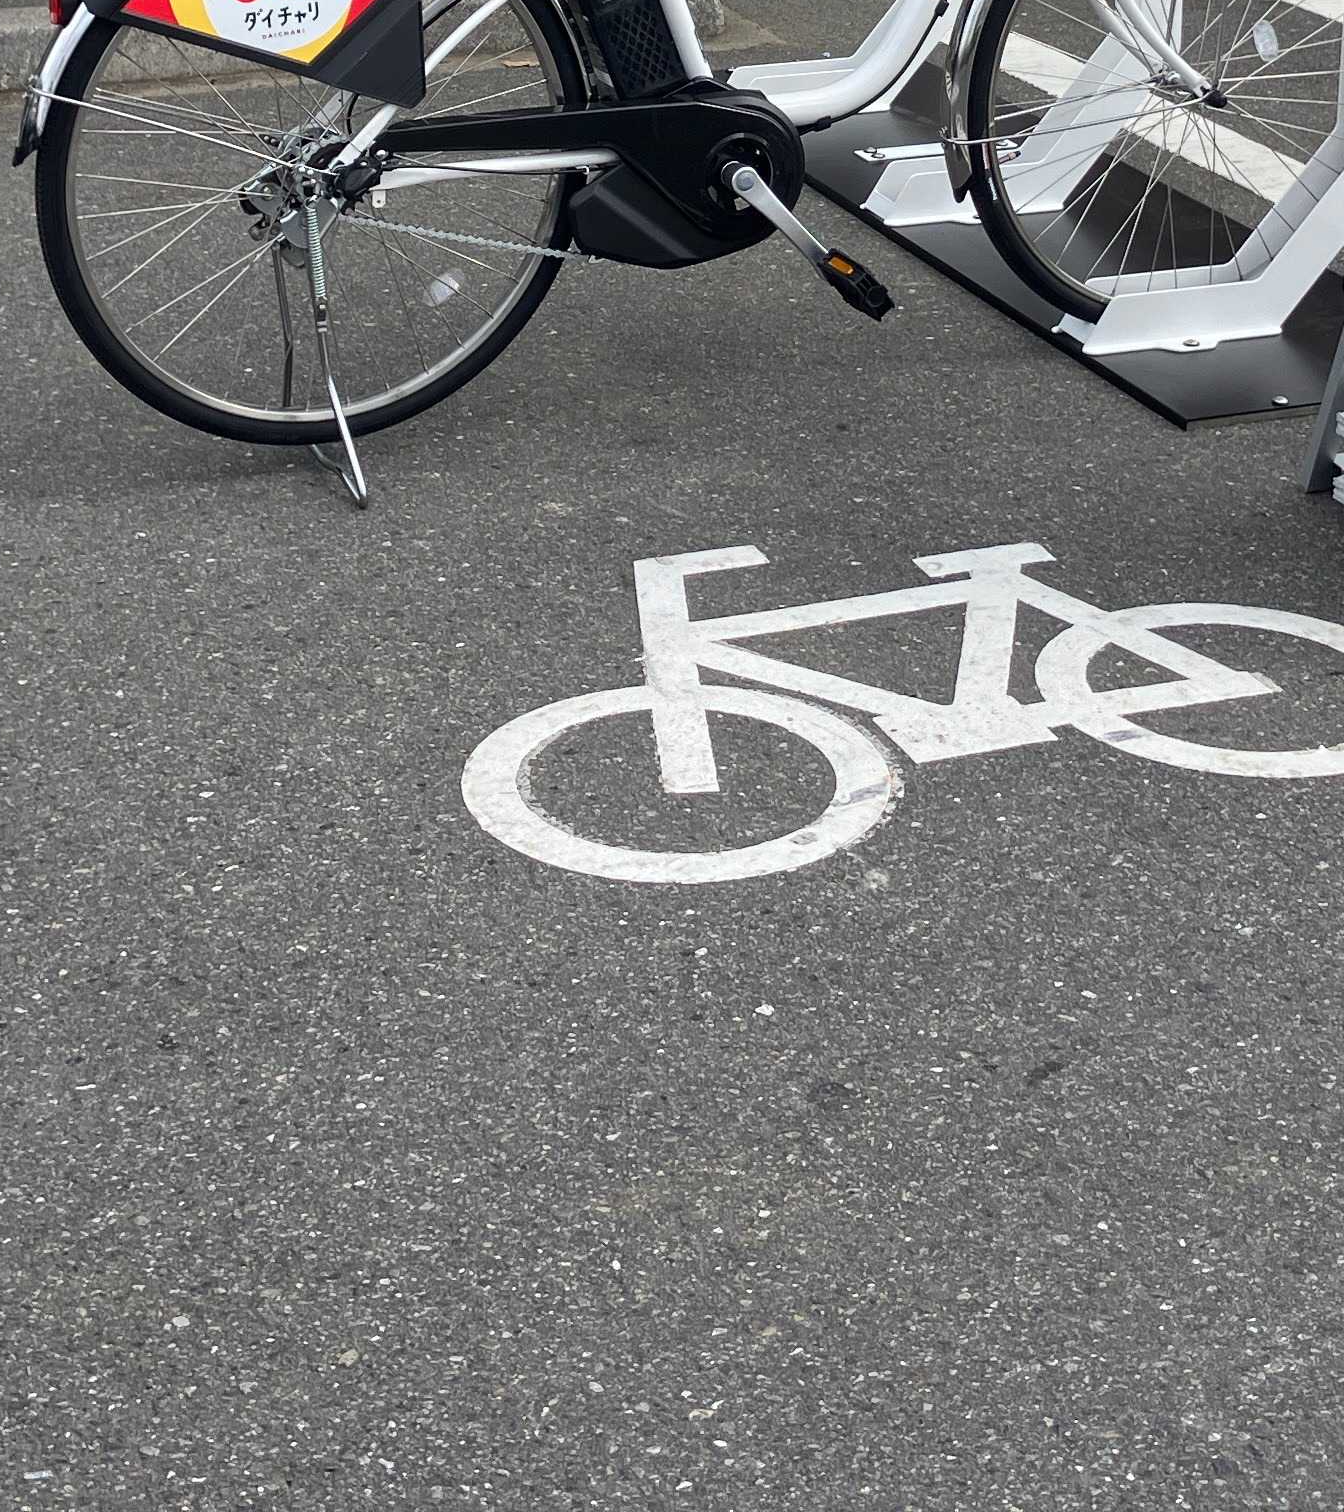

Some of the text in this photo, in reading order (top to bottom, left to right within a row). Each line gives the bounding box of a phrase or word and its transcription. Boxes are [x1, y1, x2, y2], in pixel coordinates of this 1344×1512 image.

[244, 1, 320, 30] ダイチャリ
[261, 27, 306, 40] DAICHARI
